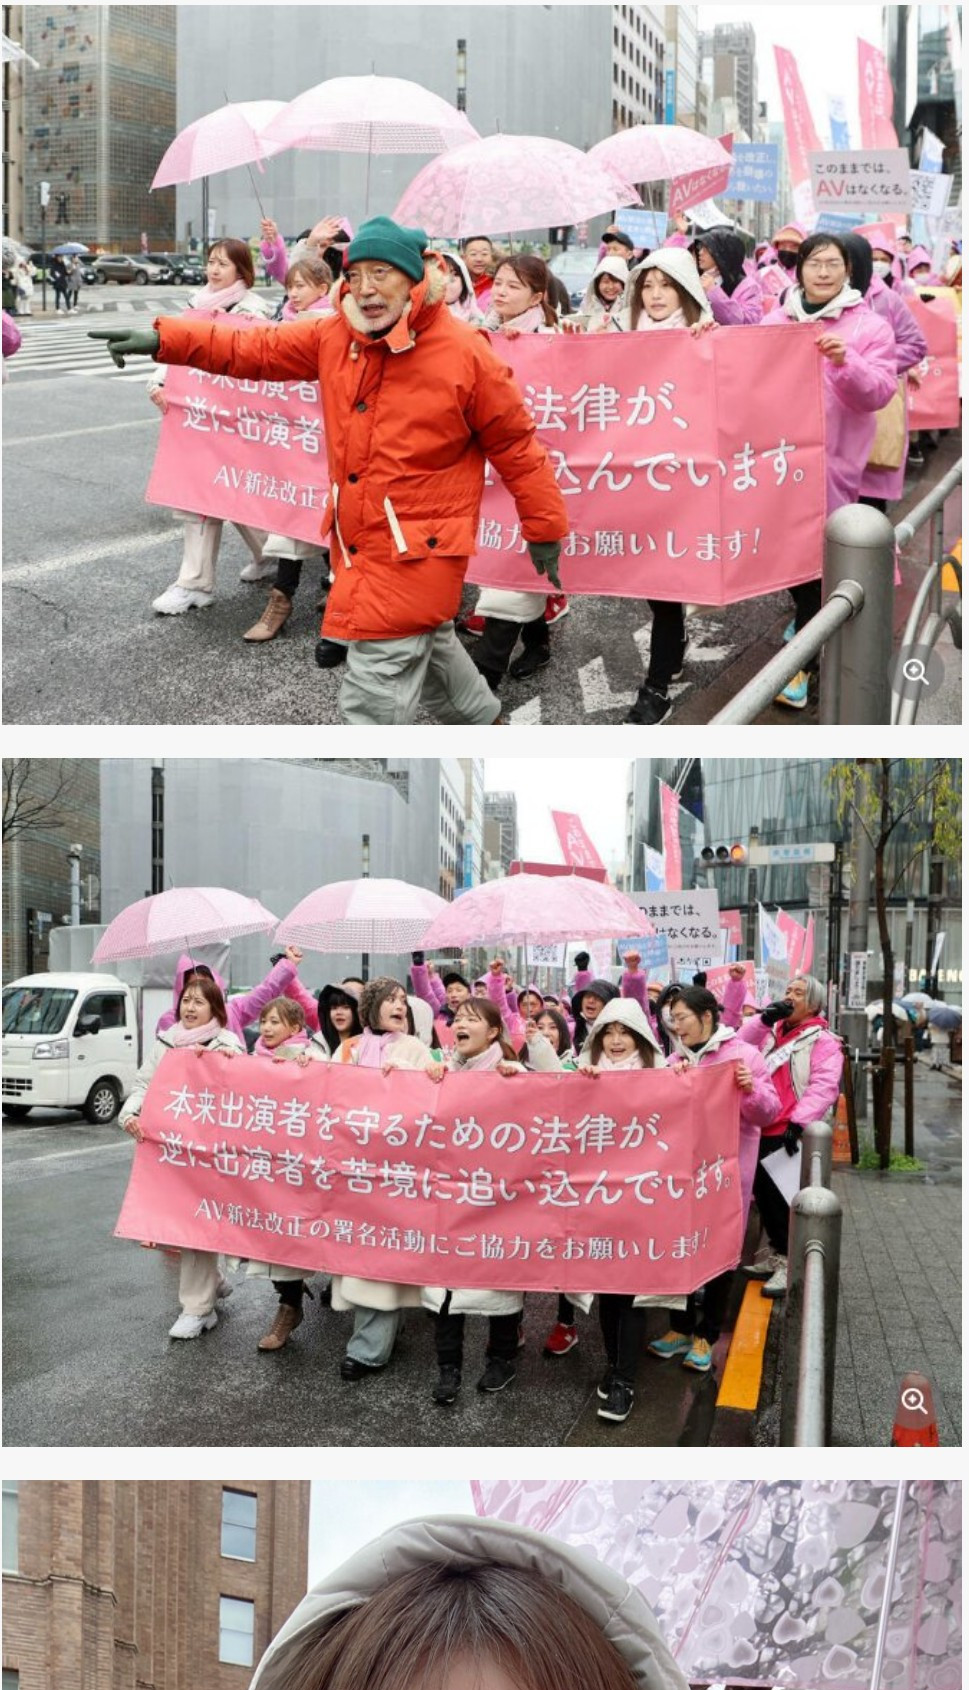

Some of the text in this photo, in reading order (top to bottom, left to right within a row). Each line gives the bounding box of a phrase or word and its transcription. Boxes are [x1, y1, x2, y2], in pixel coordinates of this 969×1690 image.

[816, 163, 891, 175] このままでは、
[816, 180, 909, 197] AVはなくなる。
[182, 396, 322, 454] 逆に出演者
[524, 382, 688, 432] 法律が、
[164, 1084, 669, 1155] 本来出演者を守るための法律が、
[158, 1131, 732, 1207] 逆に出演者を苦境に追い込んでいます。
[194, 1198, 709, 1260] AV新法改正の署名活動にご協力をお願いします!
